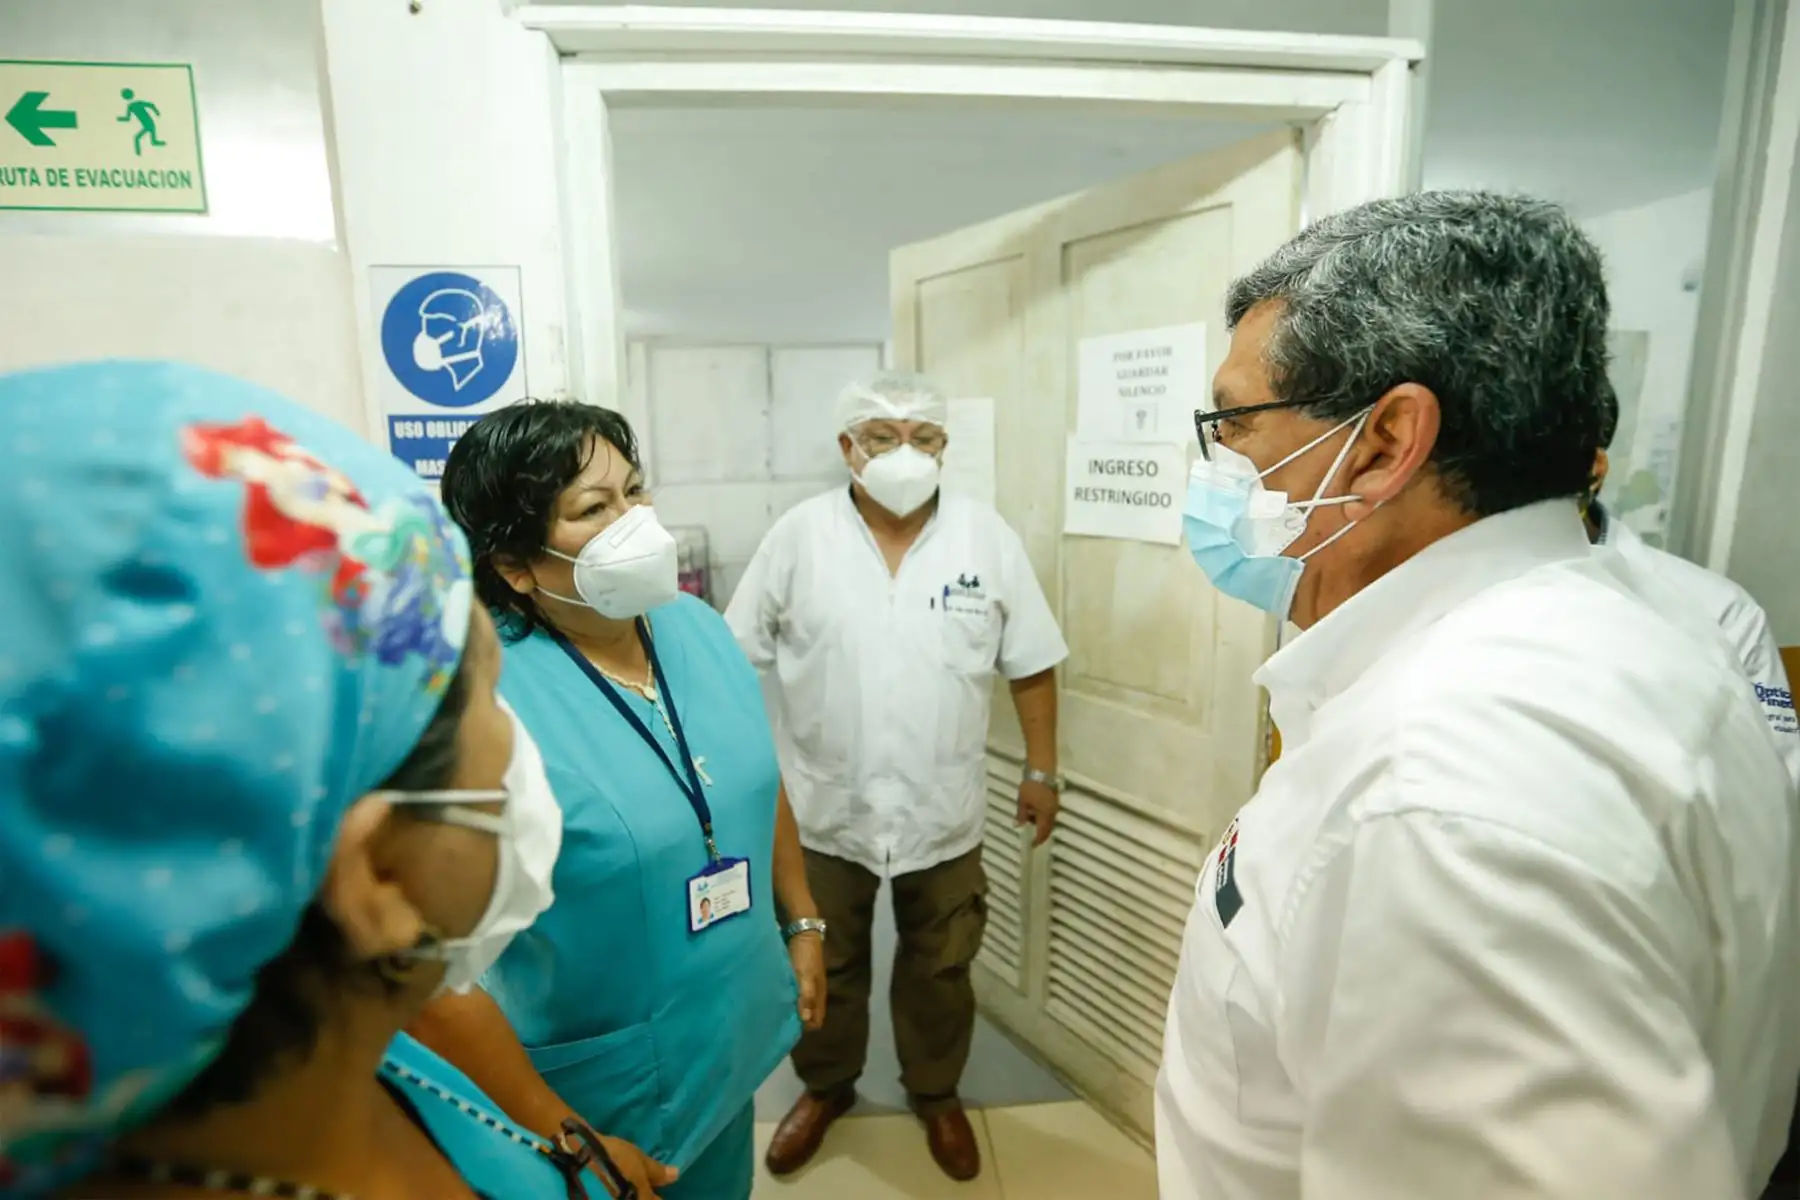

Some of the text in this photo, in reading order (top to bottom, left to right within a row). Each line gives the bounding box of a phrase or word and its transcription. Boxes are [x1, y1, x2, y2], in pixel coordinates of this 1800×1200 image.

[45, 168, 70, 188] DE
[75, 168, 193, 189] EVACUACION
[394, 420, 477, 439] USO OBLIG
[415, 459, 447, 477] MAS
[1088, 459, 1159, 478] INGRESO
[1074, 486, 1173, 508] RESTRINGIDO
